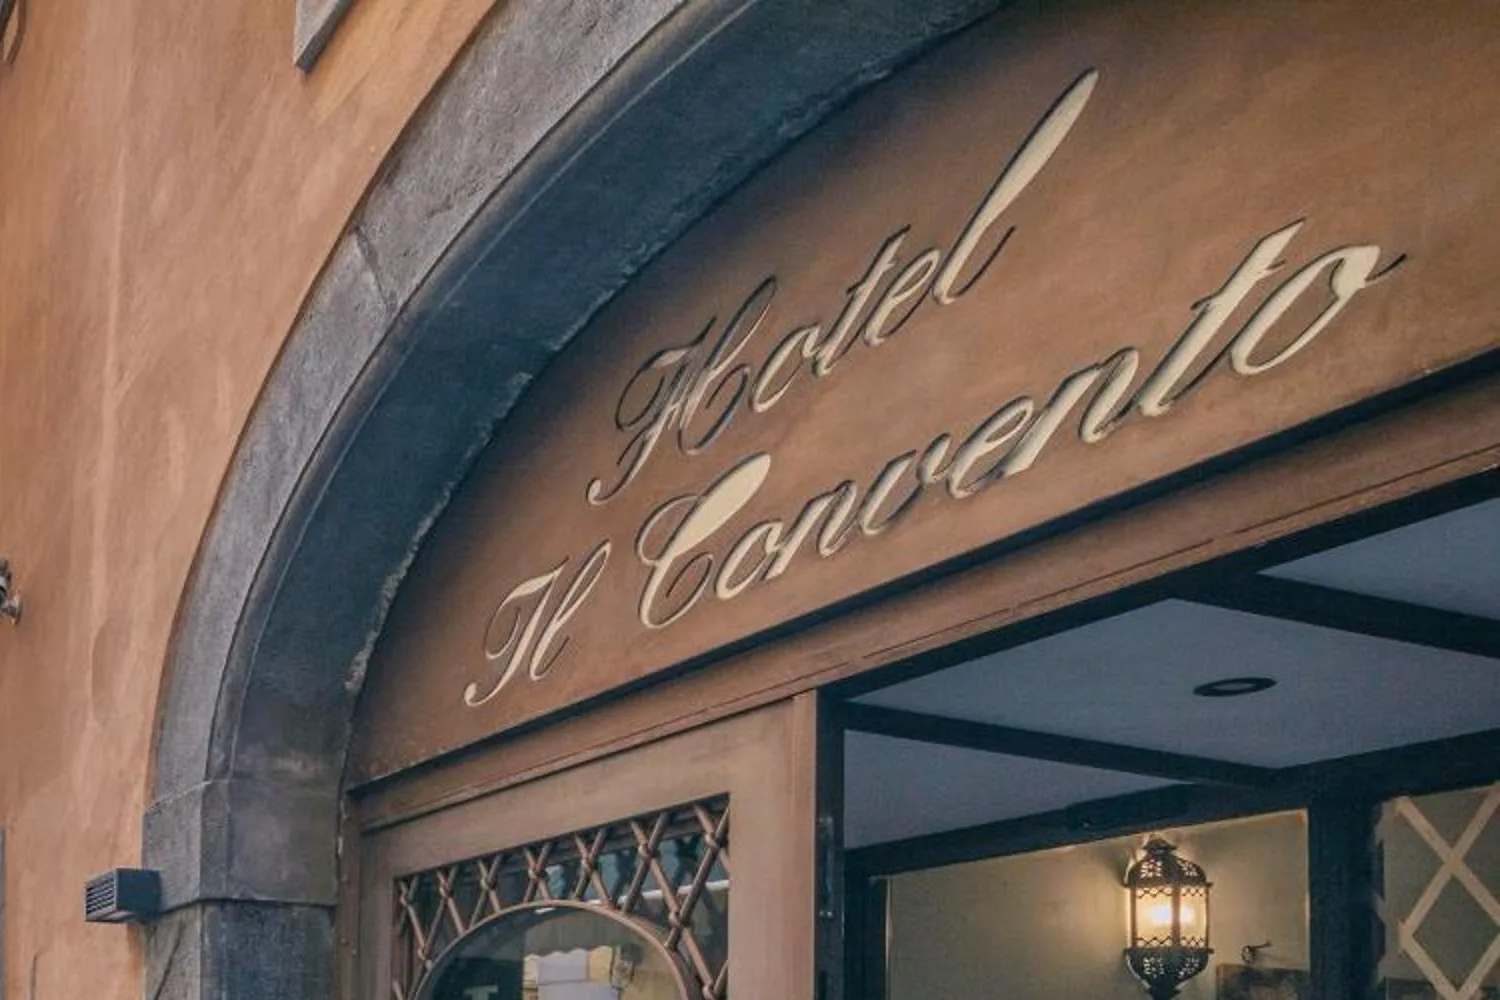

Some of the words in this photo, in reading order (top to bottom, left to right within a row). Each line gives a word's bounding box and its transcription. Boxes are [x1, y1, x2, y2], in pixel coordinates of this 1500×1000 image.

[464, 541, 611, 707] Il
[634, 216, 1407, 632] Convento
[587, 67, 1099, 506] Hotel
